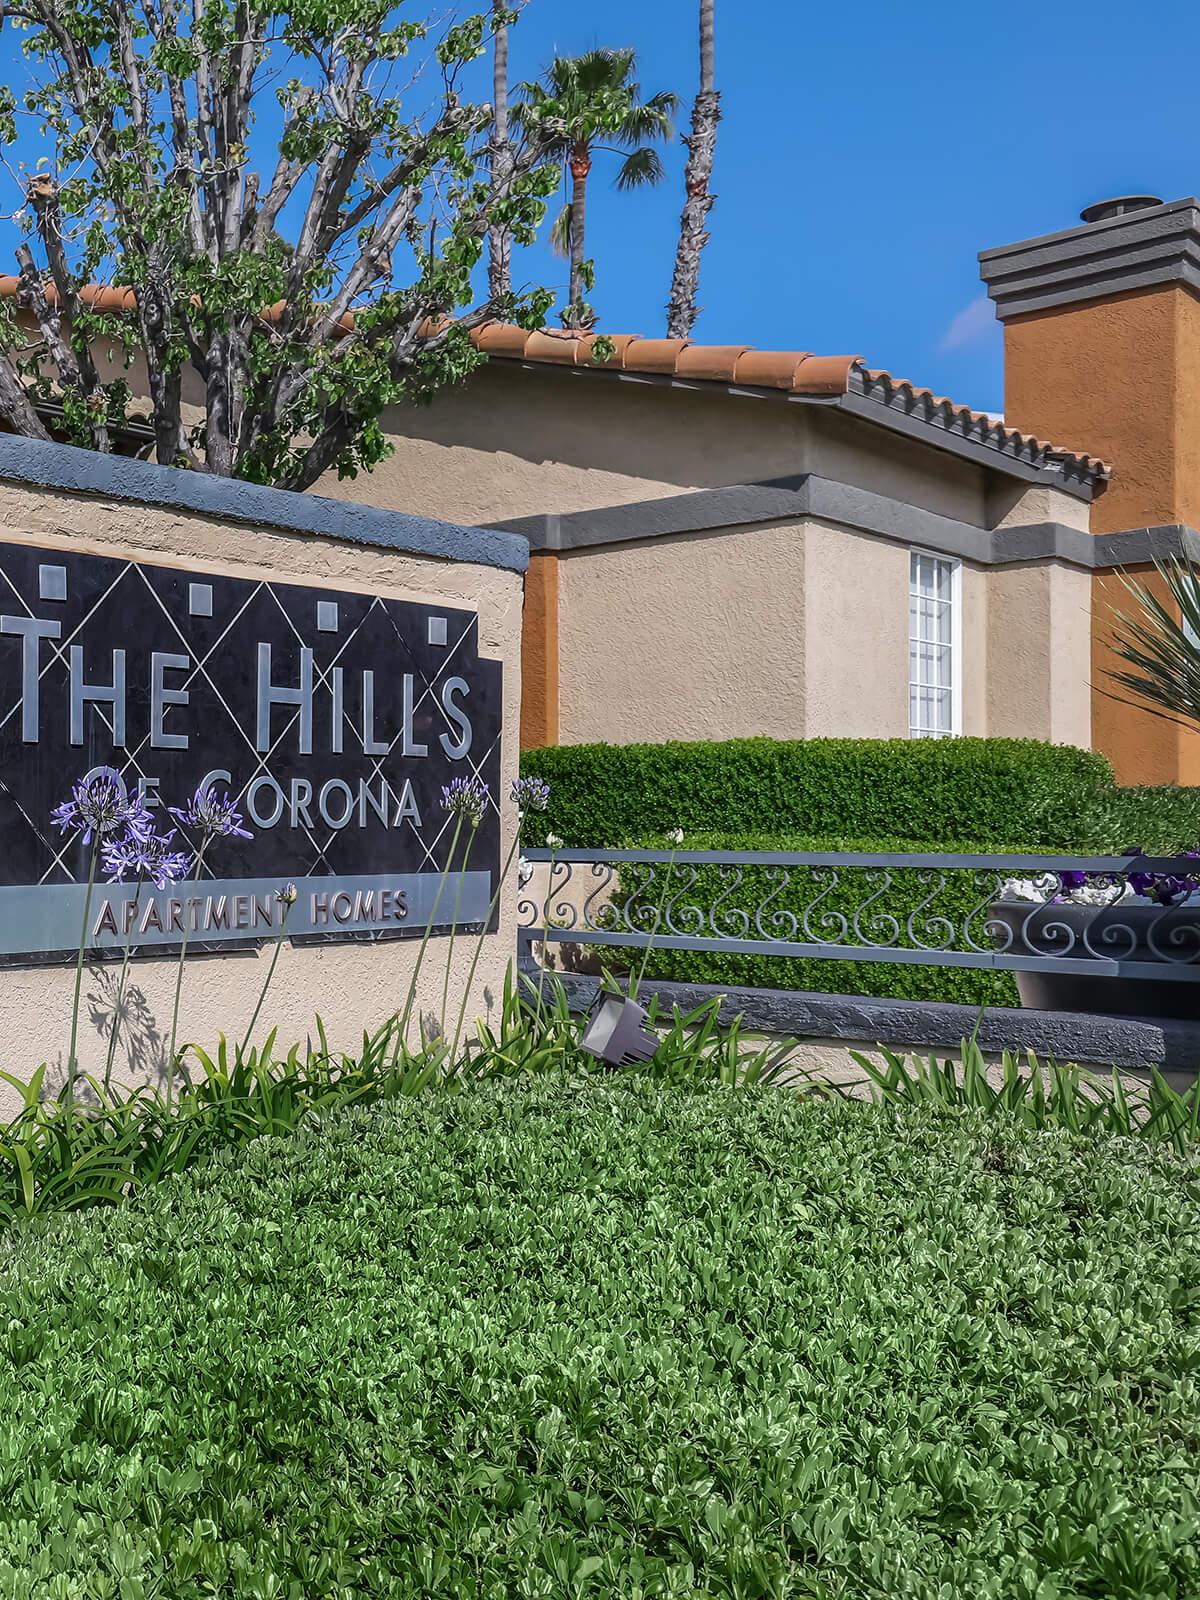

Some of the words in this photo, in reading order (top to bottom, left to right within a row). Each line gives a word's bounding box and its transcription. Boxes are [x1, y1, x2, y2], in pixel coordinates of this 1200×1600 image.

[0, 614, 190, 749] THE
[257, 642, 473, 760] HILLS
[199, 769, 422, 834] CORONA
[311, 890, 409, 924] HOMES
